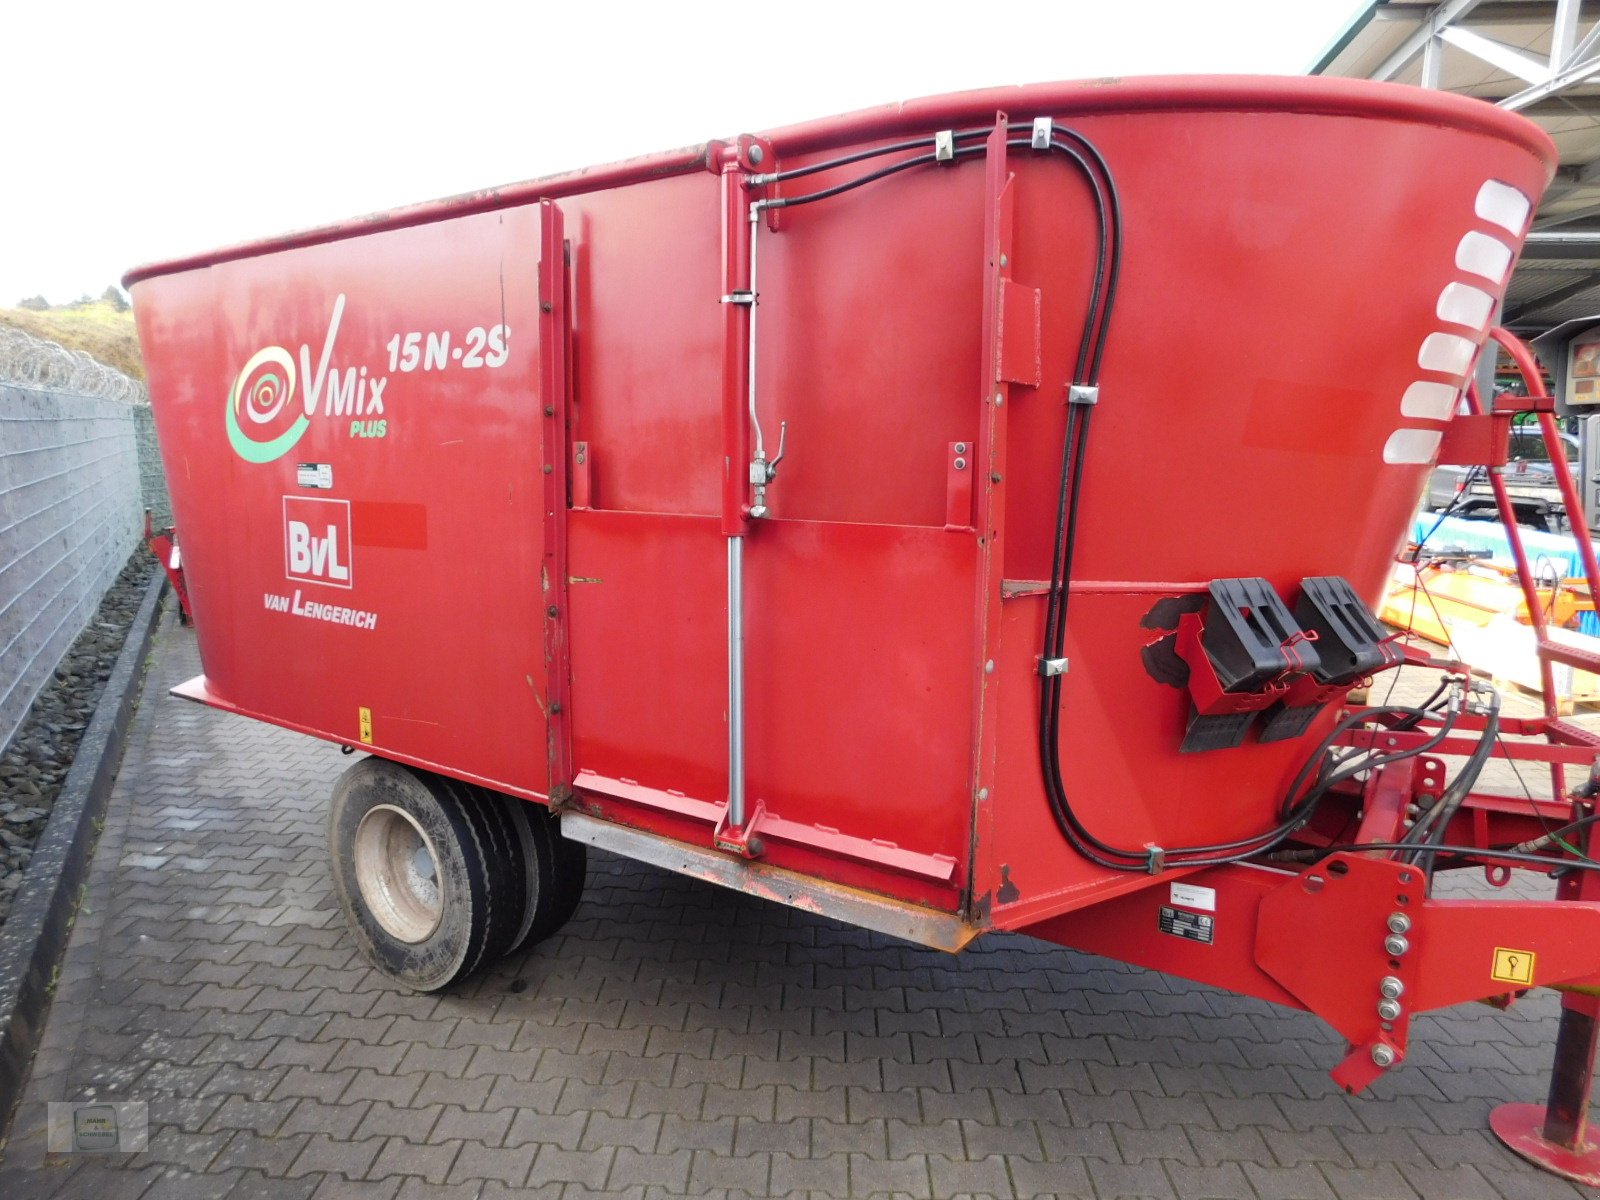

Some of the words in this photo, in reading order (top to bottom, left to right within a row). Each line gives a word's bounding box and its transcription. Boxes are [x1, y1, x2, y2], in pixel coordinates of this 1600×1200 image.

[350, 419, 387, 438] PLUS
[289, 520, 348, 580] BvL
[264, 593, 290, 613] VAN
